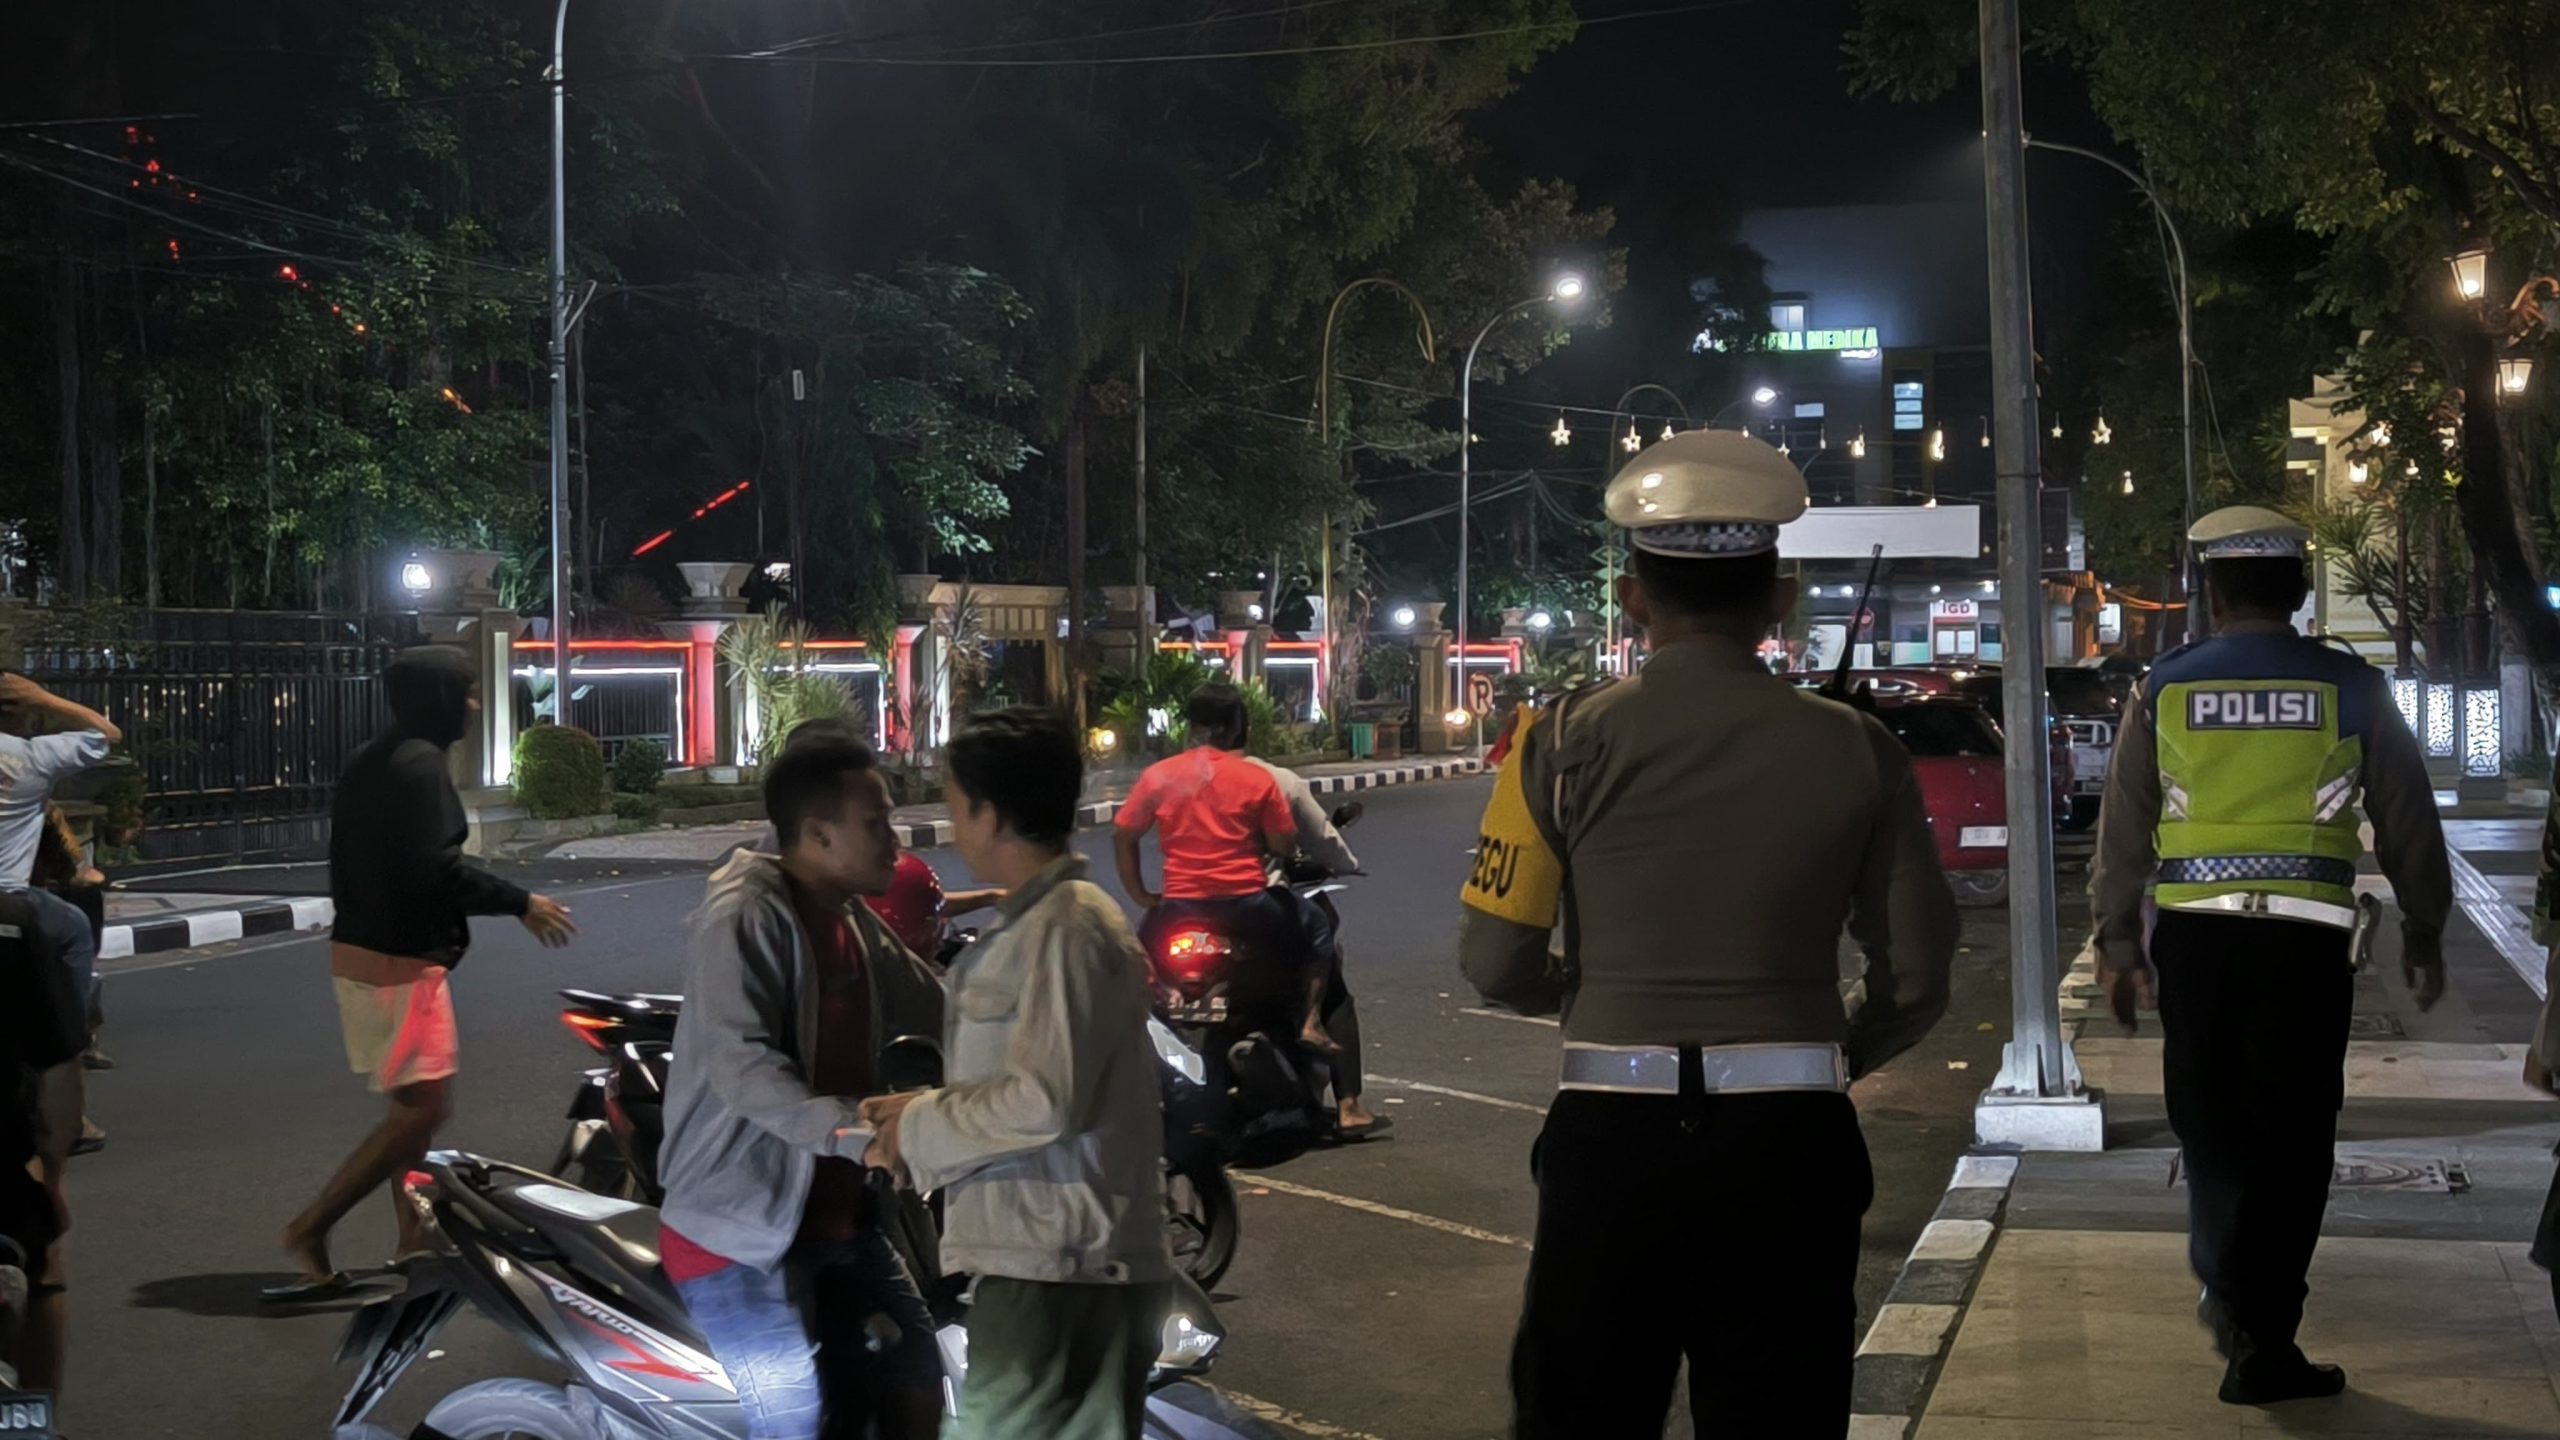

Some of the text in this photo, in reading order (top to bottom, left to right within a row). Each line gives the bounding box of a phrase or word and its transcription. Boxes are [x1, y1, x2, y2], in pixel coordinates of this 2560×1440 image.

[1943, 603, 1970, 614] IGD
[2194, 692, 2316, 724] POLISI
[551, 1284, 634, 1334] VARIO
